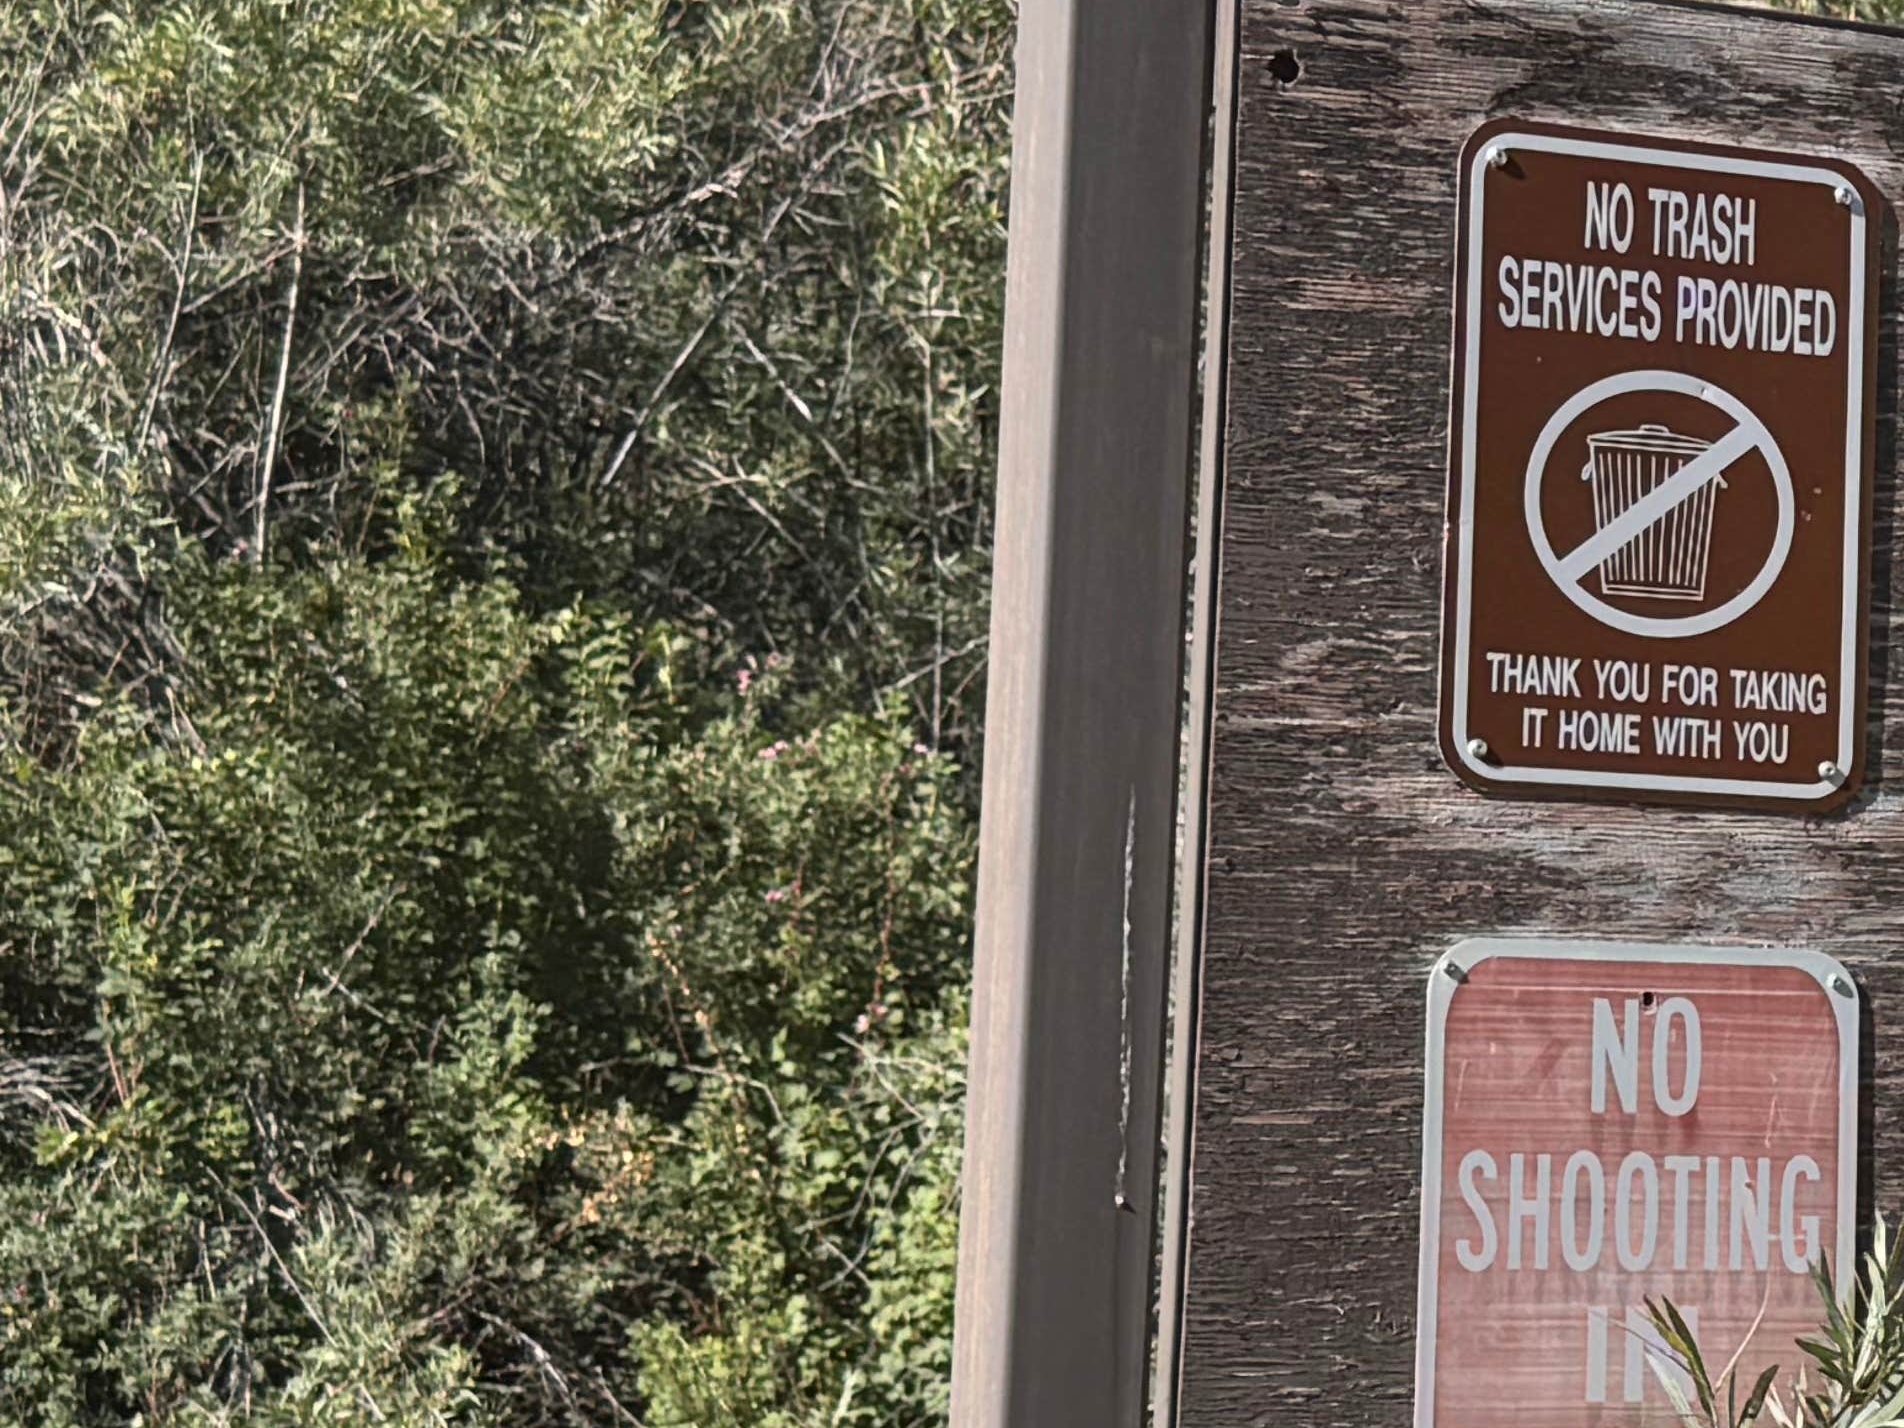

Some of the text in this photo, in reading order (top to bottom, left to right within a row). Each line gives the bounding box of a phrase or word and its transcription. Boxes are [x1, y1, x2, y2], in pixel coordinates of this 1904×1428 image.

[1584, 181, 1756, 266] NO TRASH
[1499, 256, 1836, 357] SERVICES PROVIDED
[1486, 652, 1827, 715] THANK YOU FOR TAKING
[1522, 707, 1789, 764] IT HOME WITH YOU
[1591, 997, 1701, 1117] NO
[1455, 1149, 1821, 1274] SHOOTING
[1586, 1305, 1700, 1403] IN
